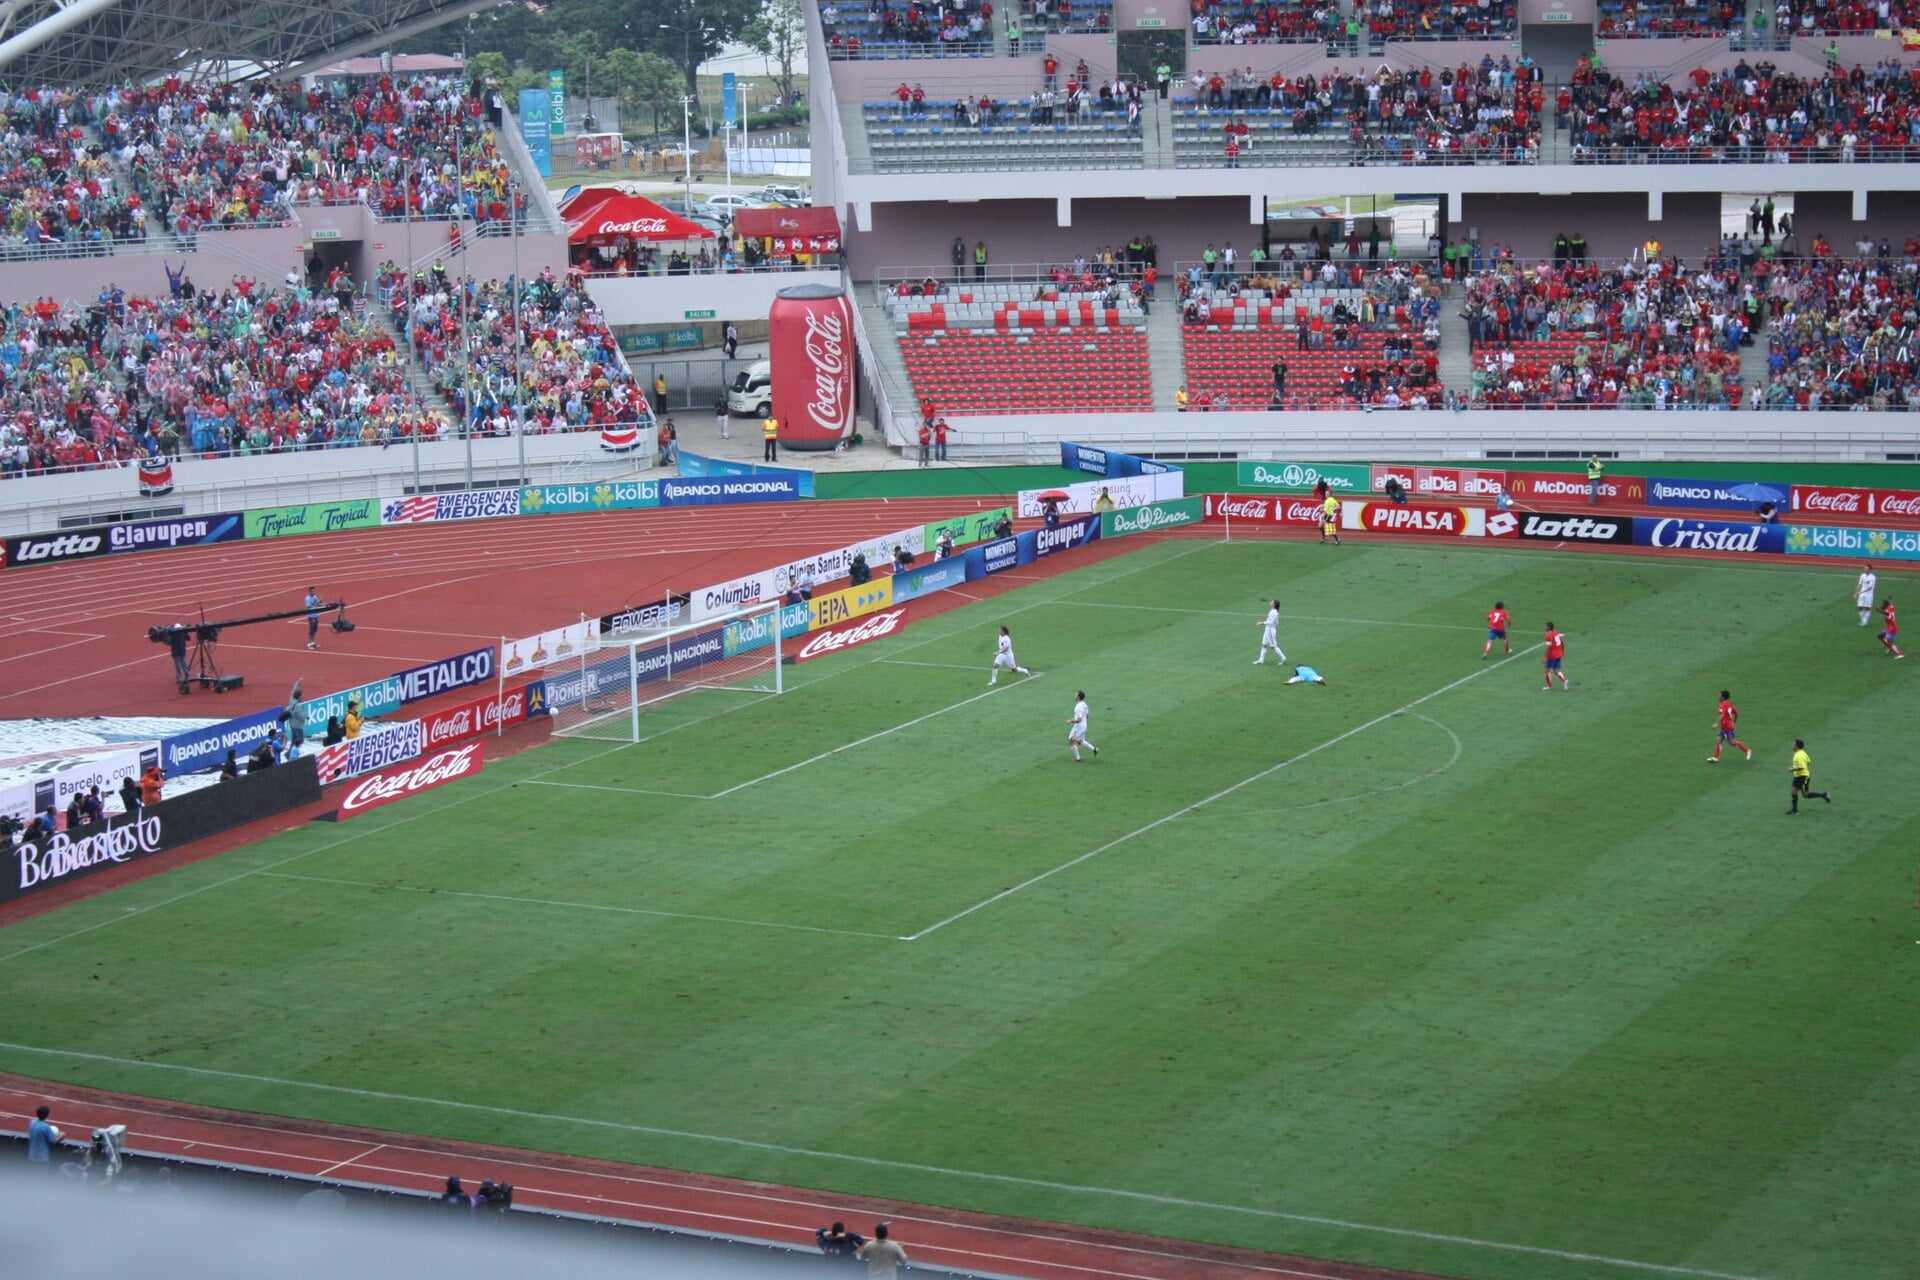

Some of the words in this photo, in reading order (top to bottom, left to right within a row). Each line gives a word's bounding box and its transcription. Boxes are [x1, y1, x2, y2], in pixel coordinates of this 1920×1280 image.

[551, 91, 563, 123] kölbi
[599, 218, 668, 233] Coca-Cola
[806, 306, 843, 429] Coca-Cola
[436, 489, 519, 508] EMERGENCIAS
[545, 487, 589, 505] kölbi
[615, 482, 658, 500] kölbi
[673, 484, 721, 497] BANCO
[723, 481, 793, 495] NACIONAL
[1090, 484, 1131, 496] Sasung
[1534, 481, 1620, 497] McDonad's
[1662, 486, 1711, 500] BANCO
[434, 501, 516, 520] MEDICAS
[1022, 502, 1079, 517] GAXY
[1091, 495, 1146, 510] AXY
[1217, 500, 1268, 518] Coca-Cola
[1287, 502, 1338, 521] Coca-C
[1805, 491, 1862, 512] Coca-Cola
[1881, 495, 1920, 515] Coca-C
[257, 507, 307, 537] Tropical
[320, 501, 370, 531] Tropical
[1152, 507, 1190, 525] Pinos
[1372, 508, 1454, 530] PIPASA
[1523, 516, 1618, 539] lotto
[110, 521, 208, 546] Clavupen
[1037, 523, 1085, 549] Clavupen
[1651, 518, 1761, 552] Cristal
[1813, 528, 1862, 549] kölbi
[16, 534, 101, 562] lotto
[985, 541, 1016, 561] MOMENTOS
[818, 552, 840, 574] Santa
[842, 549, 852, 567] Fe
[705, 580, 761, 610] Columbia
[781, 606, 808, 630] kölbi
[818, 595, 849, 625] EPA
[1493, 612, 1501, 623] 7
[800, 608, 906, 658] Coca-Cola
[637, 654, 672, 675] BANCO
[673, 638, 721, 663] NACIONAL
[397, 653, 490, 701] METALCO
[545, 671, 598, 706] PIONEER
[365, 681, 400, 710] kölbi
[484, 692, 524, 726] Coca-Cola
[430, 709, 472, 743] Coca-Cola
[177, 737, 220, 762] BANCO
[222, 720, 282, 748] NACIONAL
[349, 721, 420, 757] EMERGENCIAS
[346, 740, 417, 776] MEDICAS
[343, 742, 482, 809] Coca-Cola
